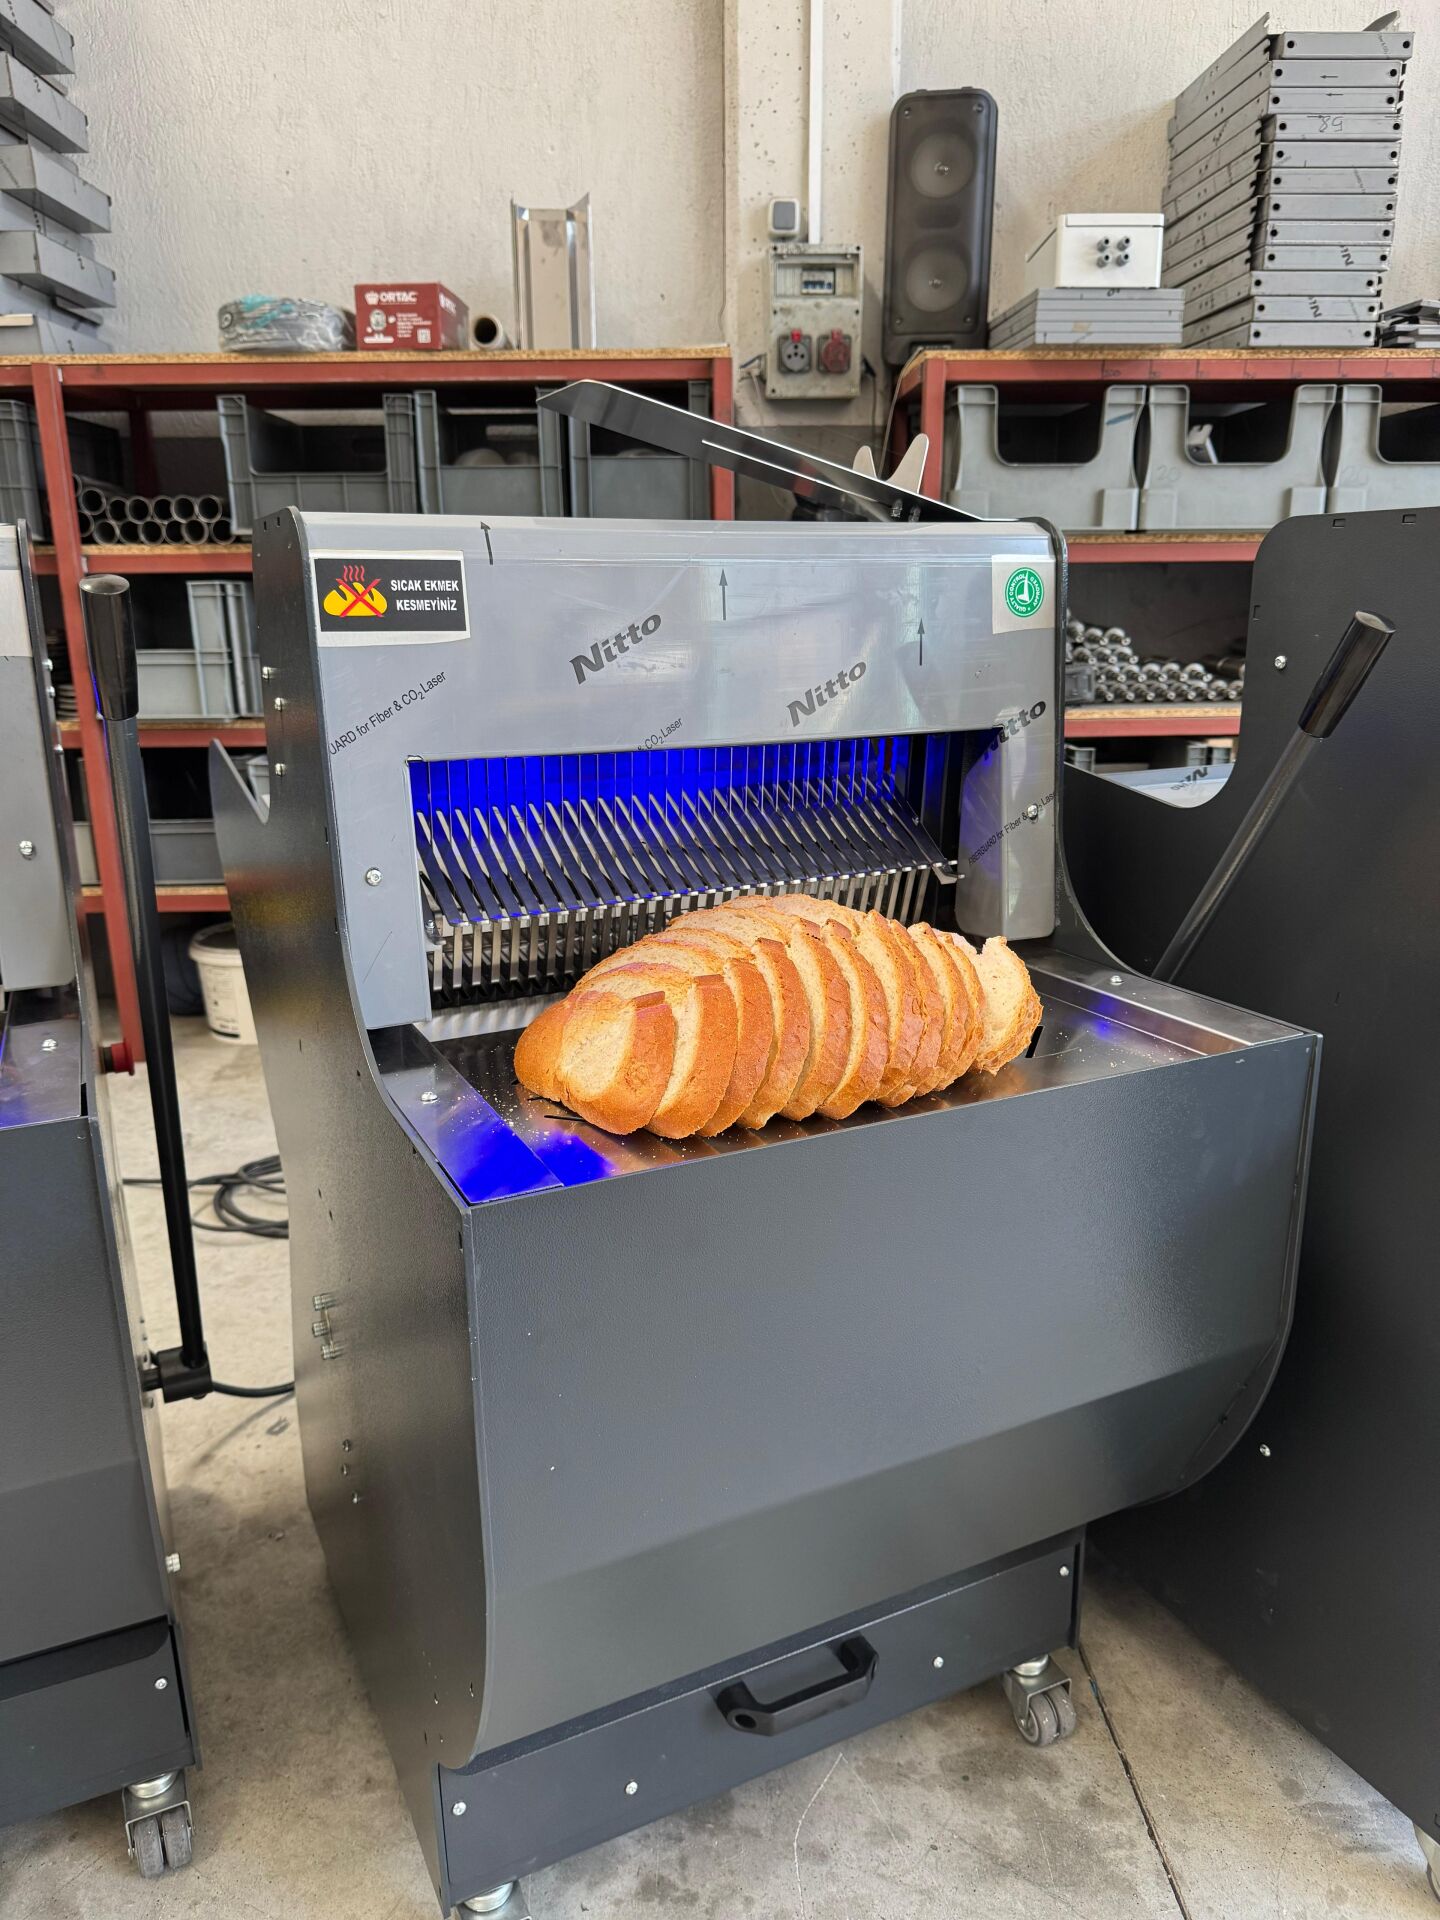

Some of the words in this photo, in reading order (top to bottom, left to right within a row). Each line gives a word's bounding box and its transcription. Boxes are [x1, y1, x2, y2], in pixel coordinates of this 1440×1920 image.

[424, 580, 459, 592] EKMEK
[1009, 573, 1026, 596] CONTROL
[396, 597, 457, 611] KESMEYİNİZ
[568, 614, 662, 685] Nitto
[355, 722, 370, 737] for
[368, 706, 394, 728] Fiber
[392, 700, 403, 711] &
[420, 671, 447, 693] Laser
[786, 661, 867, 728] Nitto
[660, 717, 683, 738] Laser
[1004, 816, 1022, 834] Fiber
